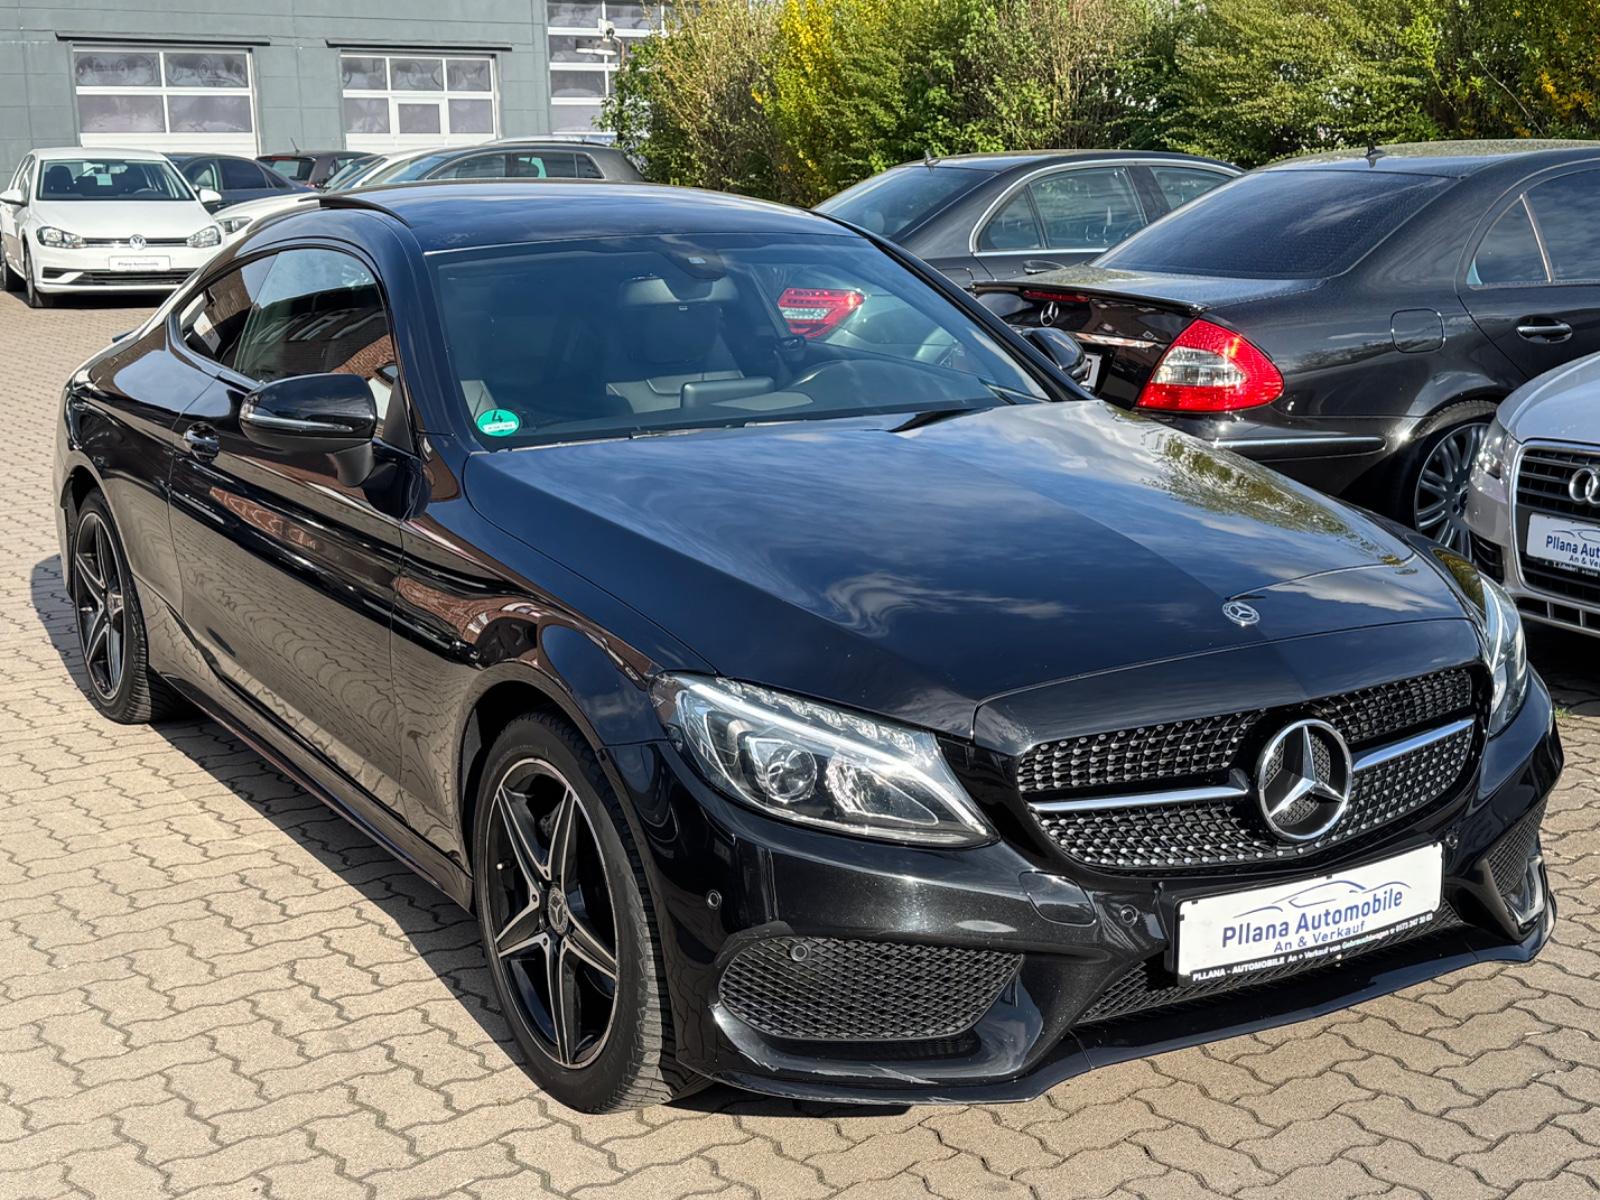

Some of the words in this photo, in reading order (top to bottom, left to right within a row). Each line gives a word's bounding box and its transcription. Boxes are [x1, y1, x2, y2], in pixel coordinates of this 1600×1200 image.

[491, 410, 504, 423] 4
[1545, 535, 1579, 554] Pllana
[1222, 921, 1289, 948] Pllana
[1295, 889, 1403, 934] Automobile
[1274, 941, 1292, 953] An
[1298, 936, 1307, 948] &
[1312, 921, 1365, 944] Verkauf
[1193, 968, 1226, 982] PLLANA
[1232, 957, 1285, 974] AUTOMOBILE
